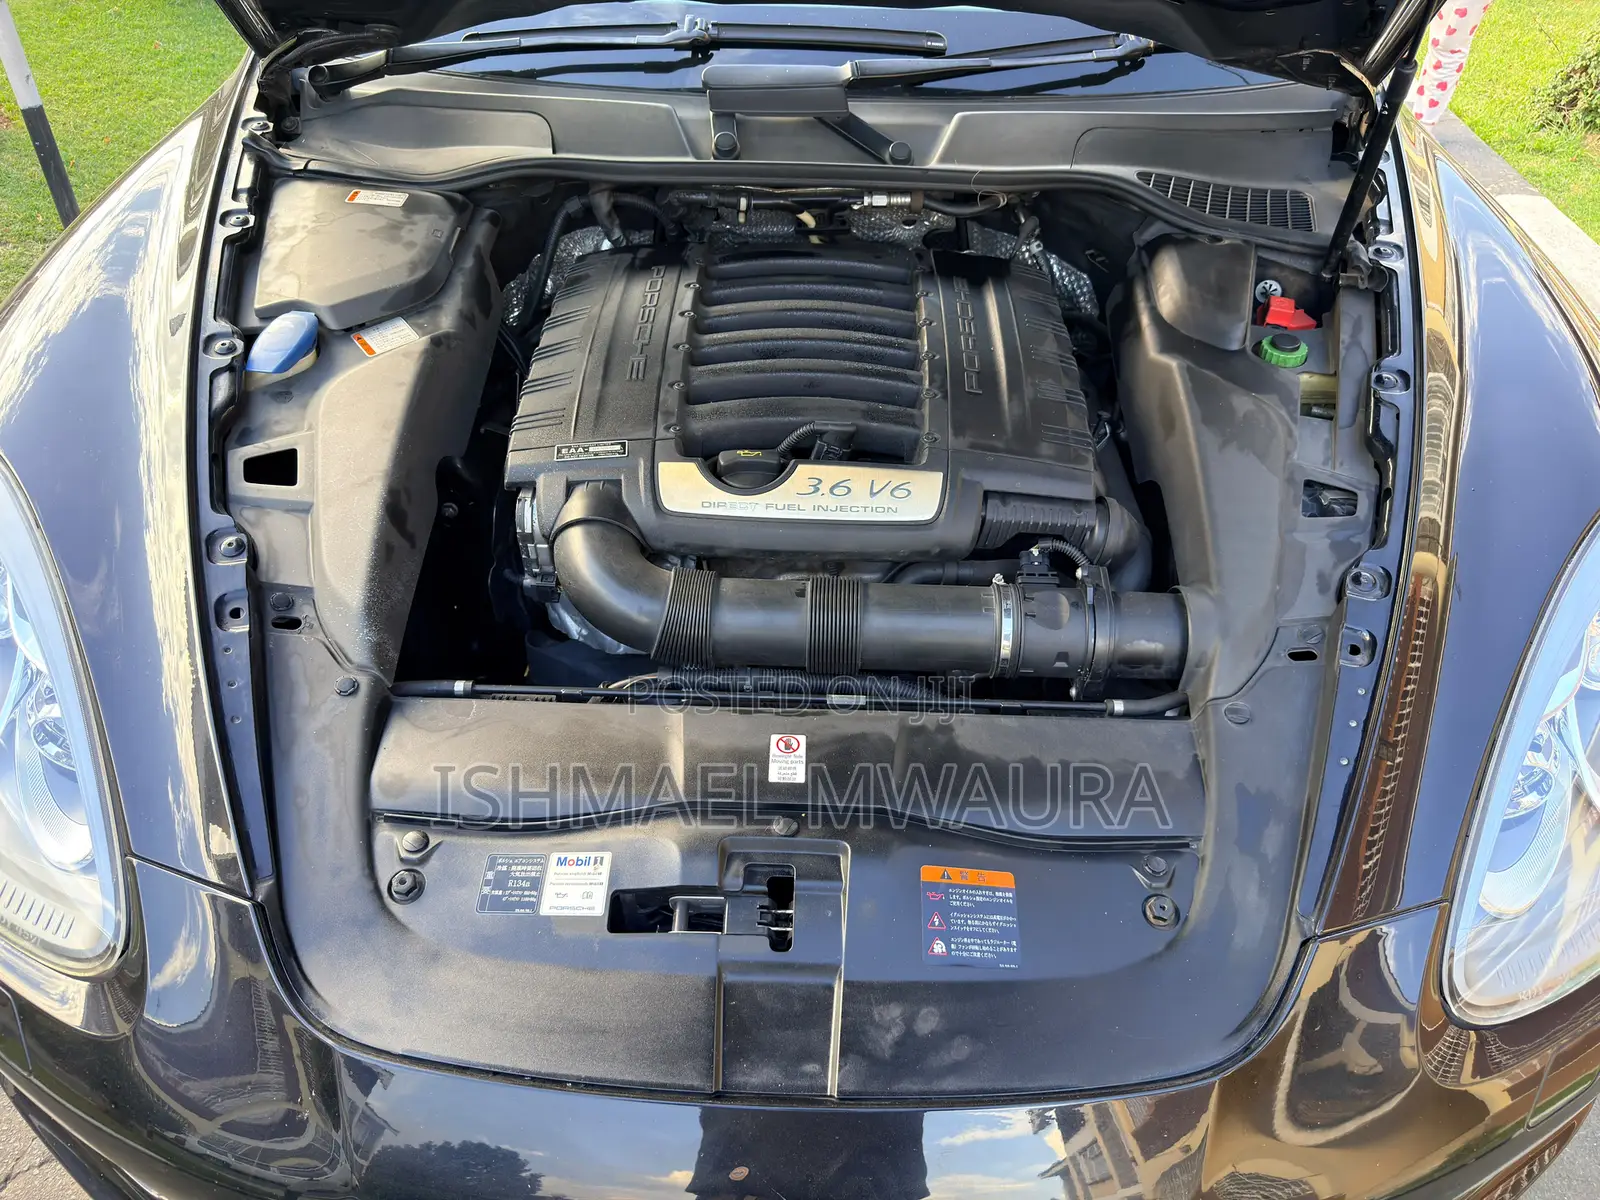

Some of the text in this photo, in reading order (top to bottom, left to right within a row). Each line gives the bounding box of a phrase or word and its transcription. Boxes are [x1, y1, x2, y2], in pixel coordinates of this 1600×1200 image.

[627, 265, 666, 380] PORSCHE
[953, 276, 982, 394] PORSCHE
[795, 476, 912, 500] 3.6 V6
[701, 500, 898, 514] DIRECT FUEL INJECTION
[556, 856, 591, 867] Mobil
[960, 870, 986, 882] 警告
[507, 879, 531, 888] R134a
